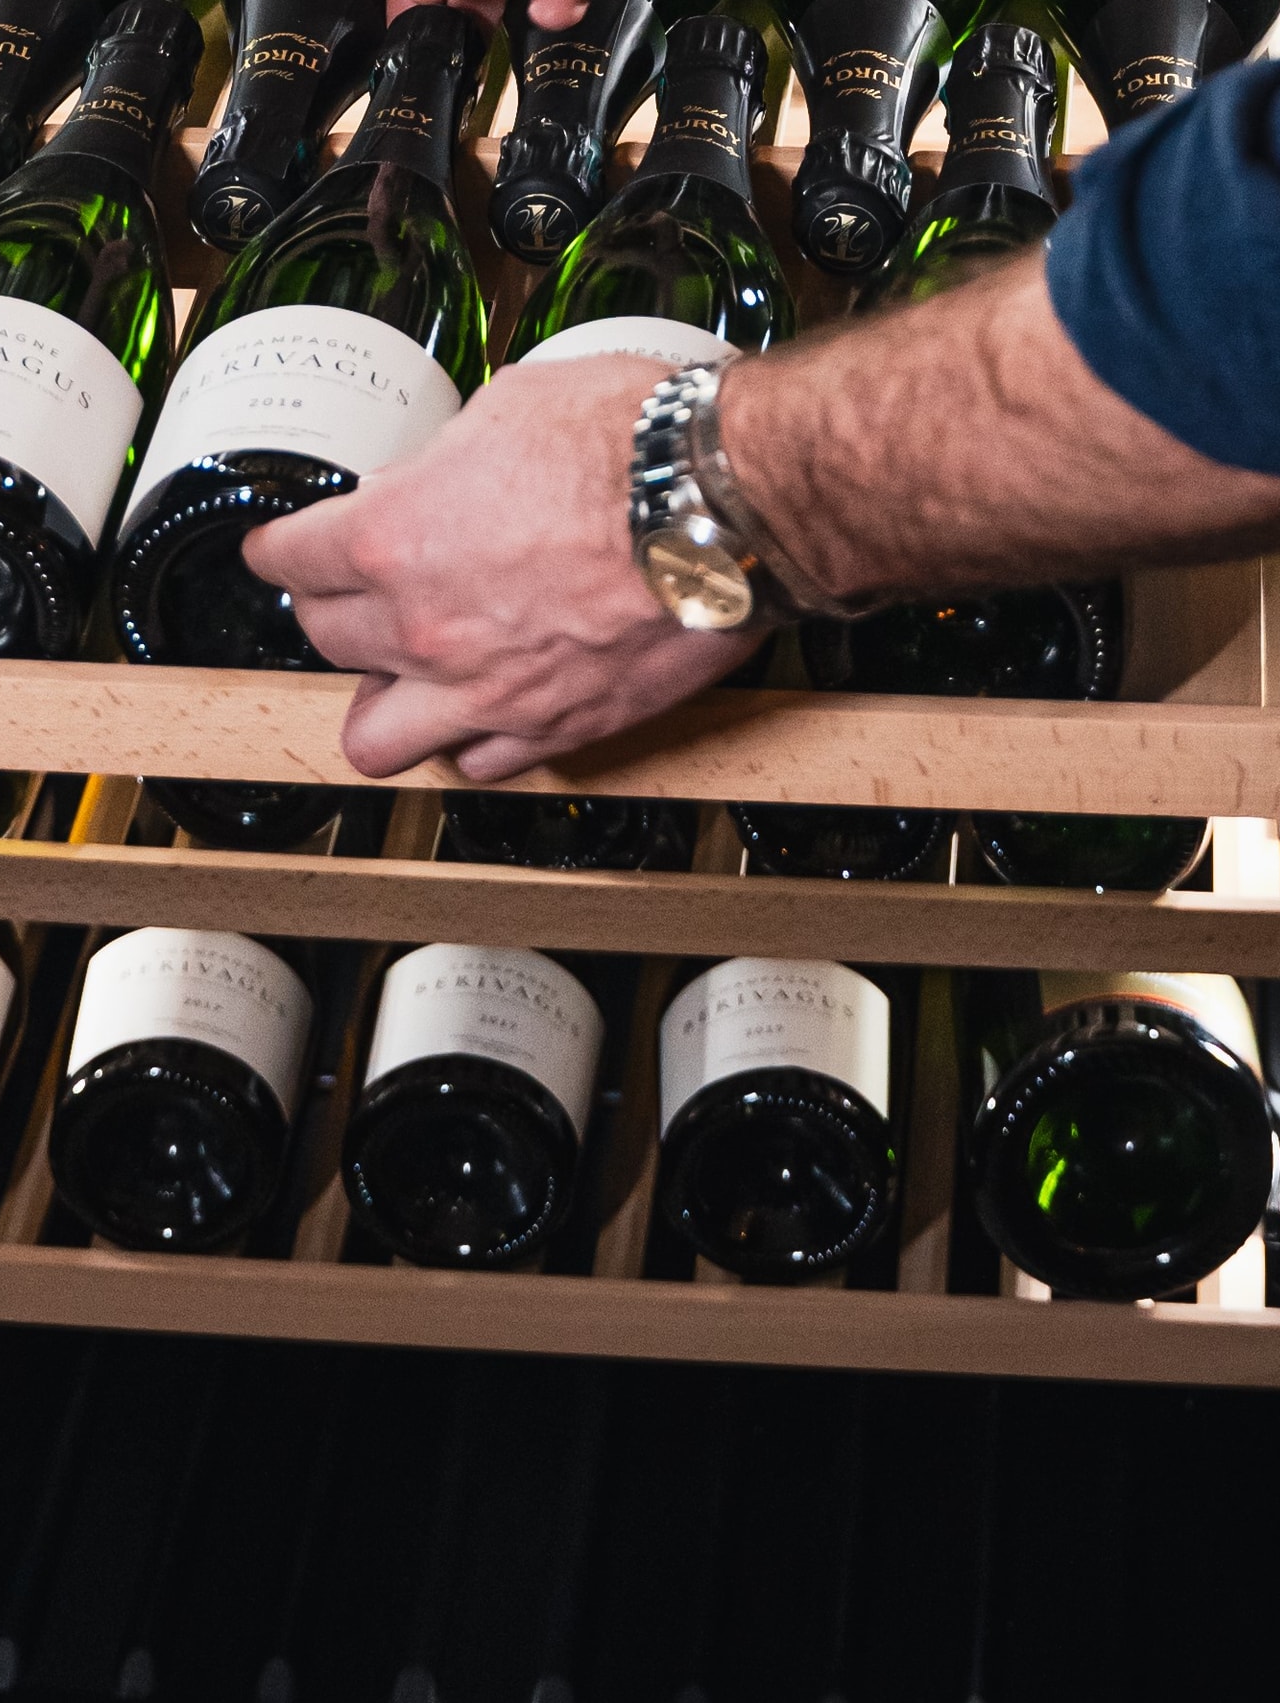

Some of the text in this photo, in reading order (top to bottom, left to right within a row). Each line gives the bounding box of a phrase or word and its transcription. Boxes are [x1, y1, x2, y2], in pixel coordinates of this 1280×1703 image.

[238, 50, 321, 73] TURGY
[77, 99, 157, 130] TURGY
[659, 119, 742, 146] TURGY
[178, 351, 411, 407] BERIVAGUS
[248, 397, 303, 408] 2018
